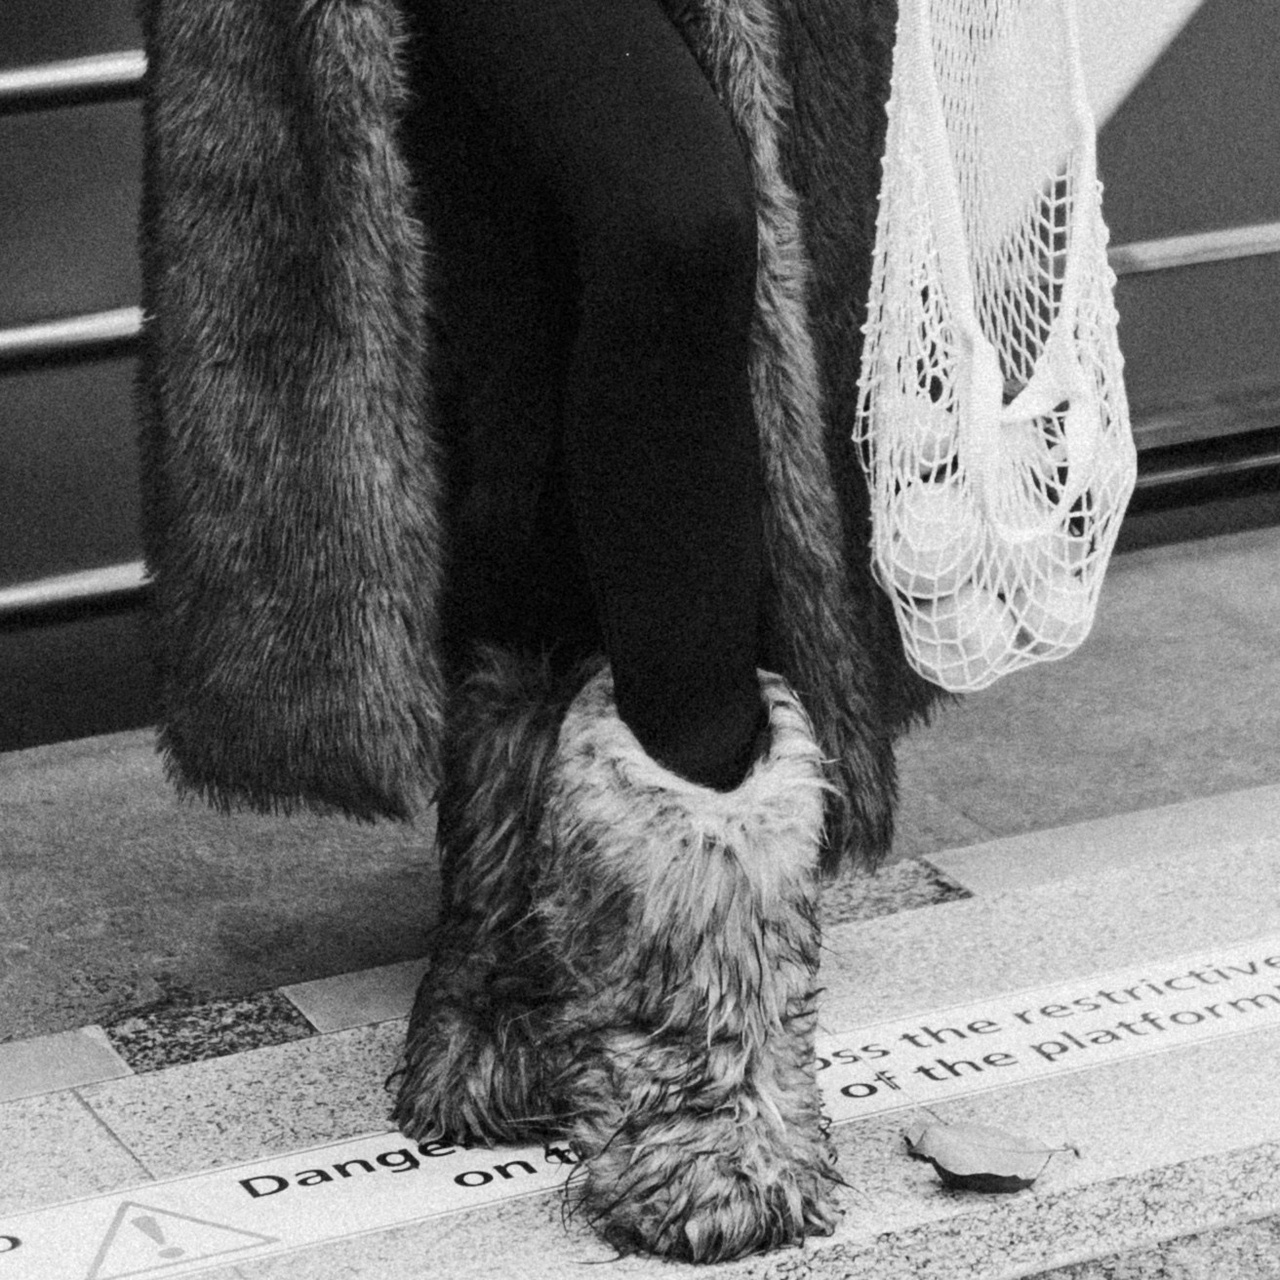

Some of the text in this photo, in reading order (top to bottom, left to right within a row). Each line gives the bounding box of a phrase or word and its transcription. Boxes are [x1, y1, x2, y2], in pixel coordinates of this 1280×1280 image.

[238, 1141, 457, 1199] Dange
[900, 1019, 1002, 1050] the
[453, 1160, 538, 1187] on
[840, 1070, 901, 1099] of
[913, 1051, 1019, 1082] the
